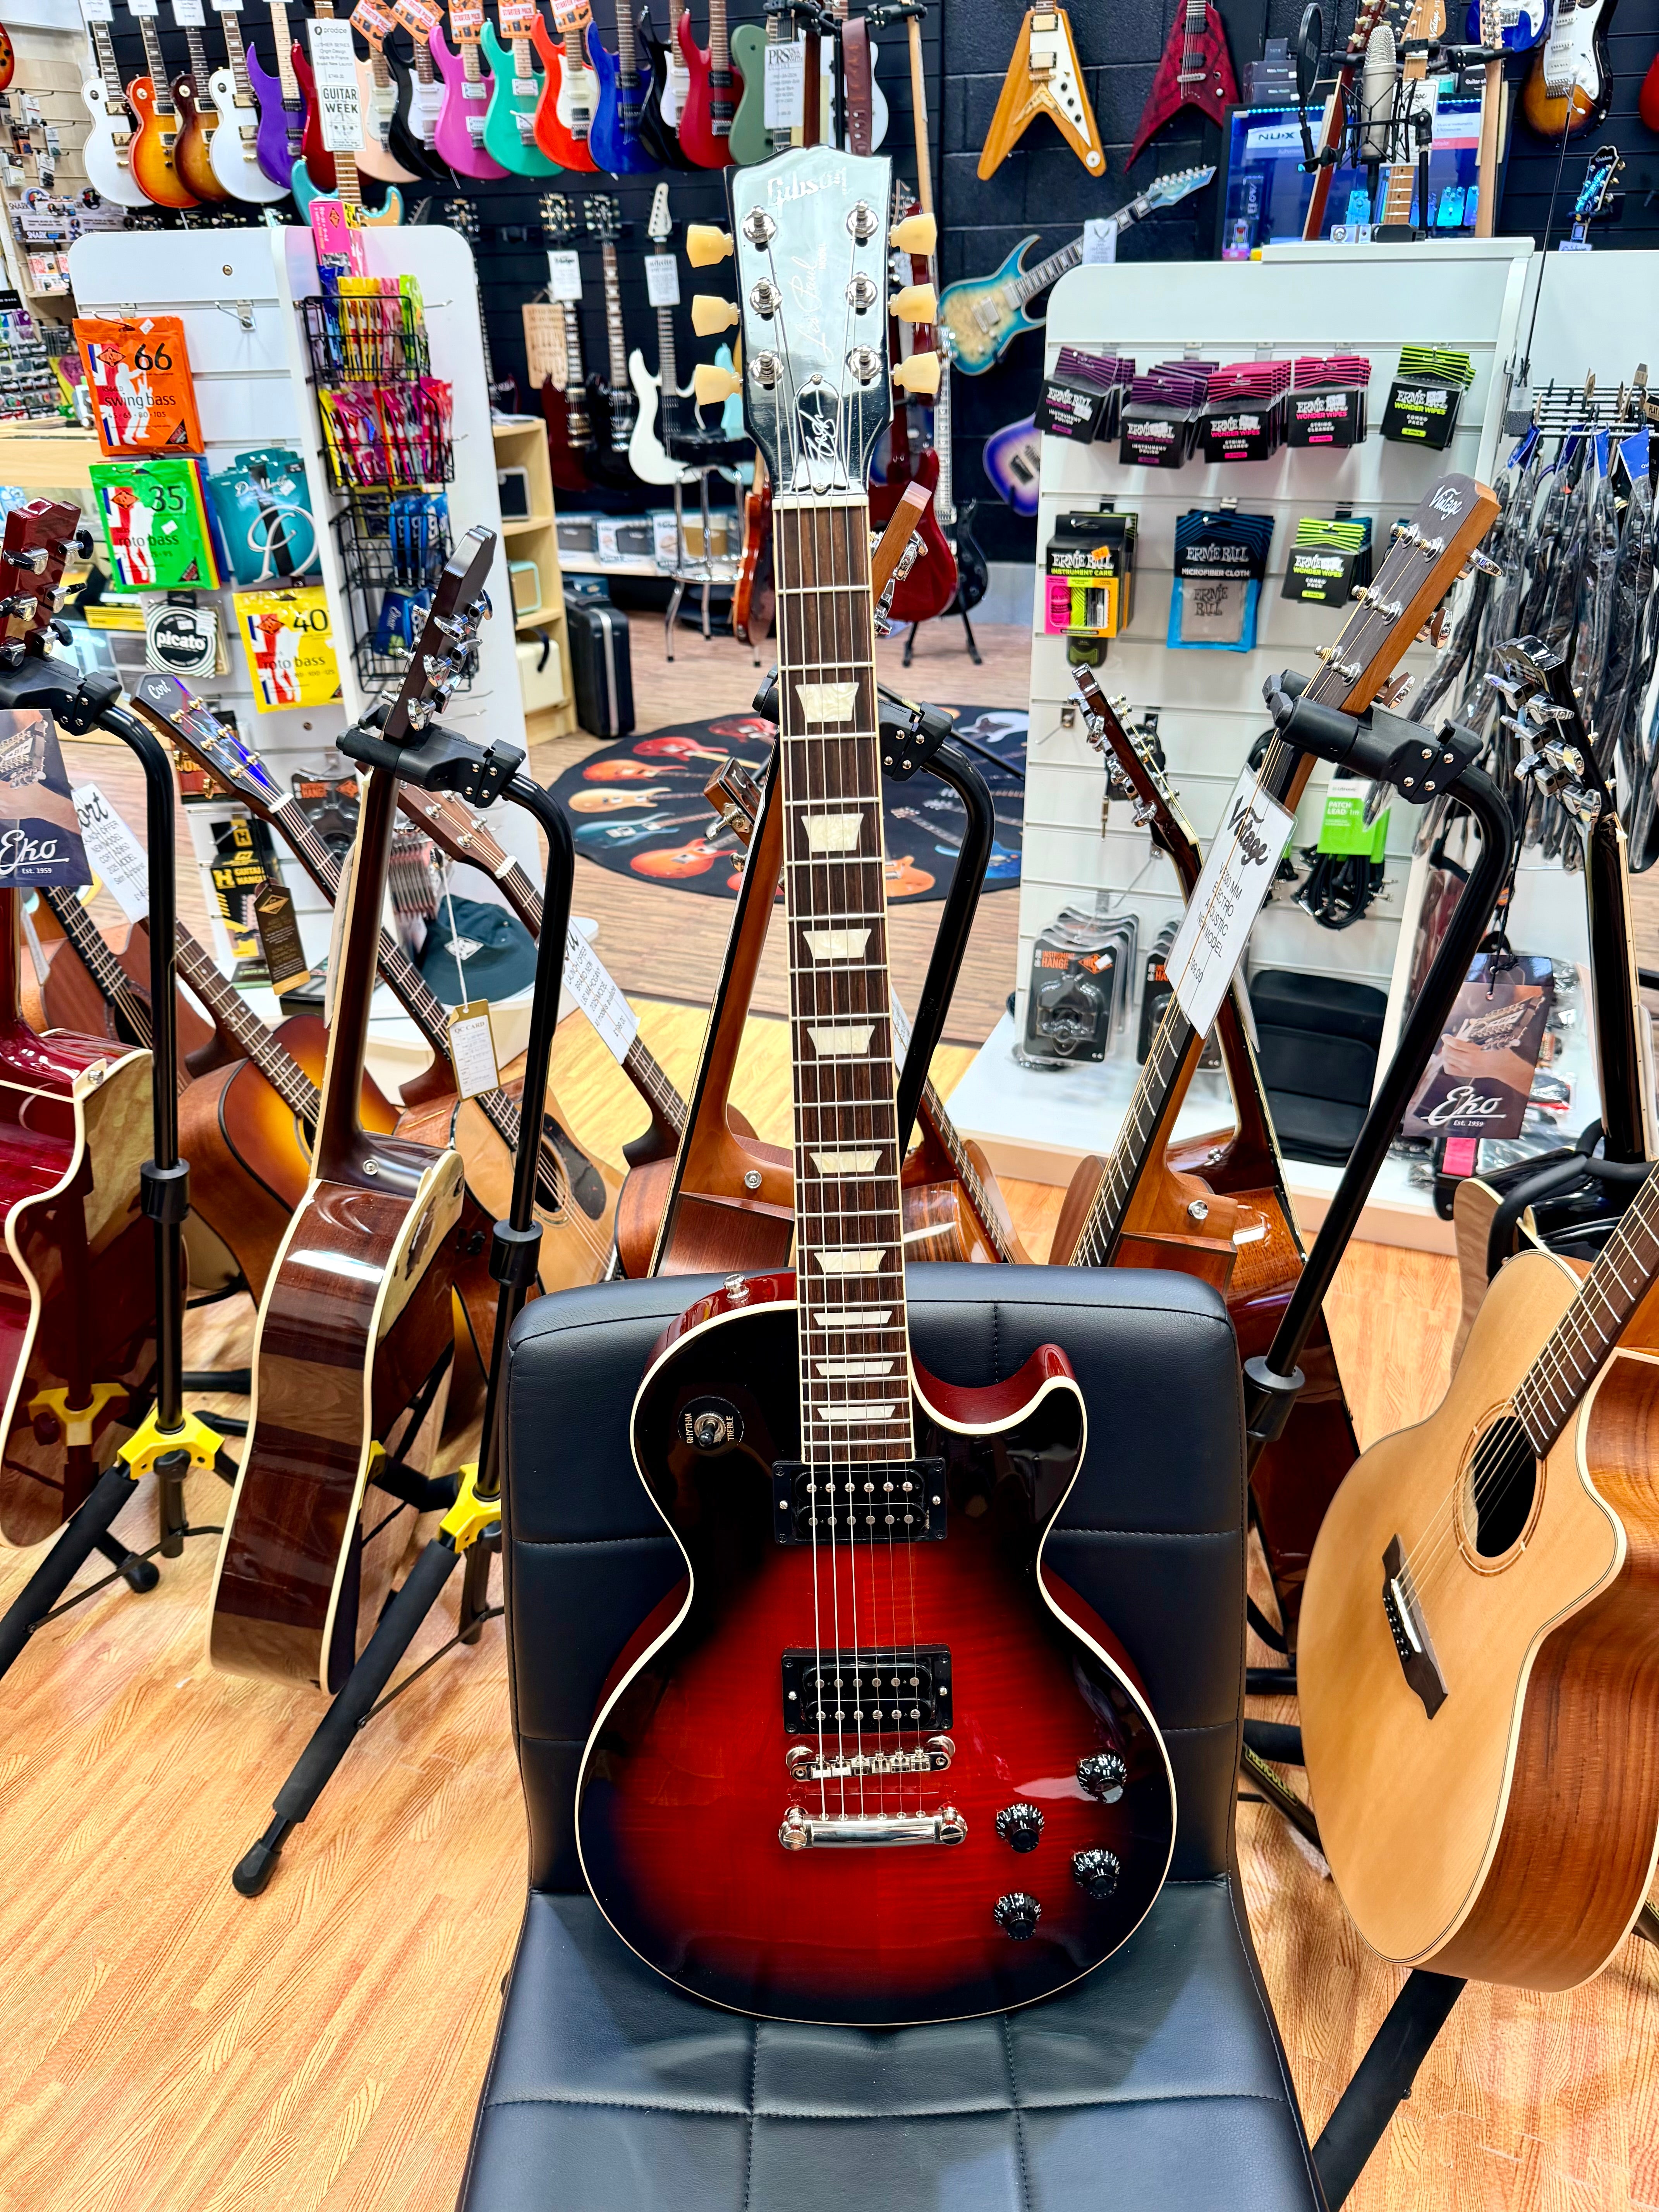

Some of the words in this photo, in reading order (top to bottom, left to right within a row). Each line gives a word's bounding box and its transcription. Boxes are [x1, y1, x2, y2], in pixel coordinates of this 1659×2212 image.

[323, 88, 357, 100] GUITAR
[325, 103, 358, 113] WEEK
[768, 167, 853, 218] Gibson
[134, 342, 172, 371] 66
[105, 392, 144, 409] swing
[146, 393, 176, 406] bass
[1395, 402, 1424, 412] WONDER
[1425, 407, 1446, 415] WIPES
[149, 486, 183, 512] 35
[1429, 485, 1462, 520] Vintage
[118, 536, 145, 546] roto
[148, 534, 180, 546] bass
[1221, 546, 1249, 562] BALL
[1182, 568, 1224, 576] MICROFIBER
[1293, 567, 1322, 575] WONDER
[1195, 602, 1223, 616] BALL
[293, 609, 328, 632] 40
[156, 630, 206, 651] picato
[263, 659, 292, 669] roto
[294, 656, 325, 668] bass
[148, 679, 172, 699] Cort
[77, 792, 108, 828] ort
[1328, 800, 1352, 809] PATCH
[0, 830, 58, 875] Eko
[235, 874, 266, 885] HANG
[1230, 880, 1242, 900] MM
[1205, 898, 1228, 936] AOUSTIC
[1205, 929, 1222, 958] MODEL
[566, 962, 579, 985] LAUNCH
[1042, 957, 1068, 970] HANGE
[1190, 954, 1203, 983] 199.00
[466, 1022, 484, 1030] CARD
[1428, 1086, 1503, 1126] Eko
[685, 1413, 694, 1443] RHYTHM
[726, 1416, 735, 1441] TREBLE
